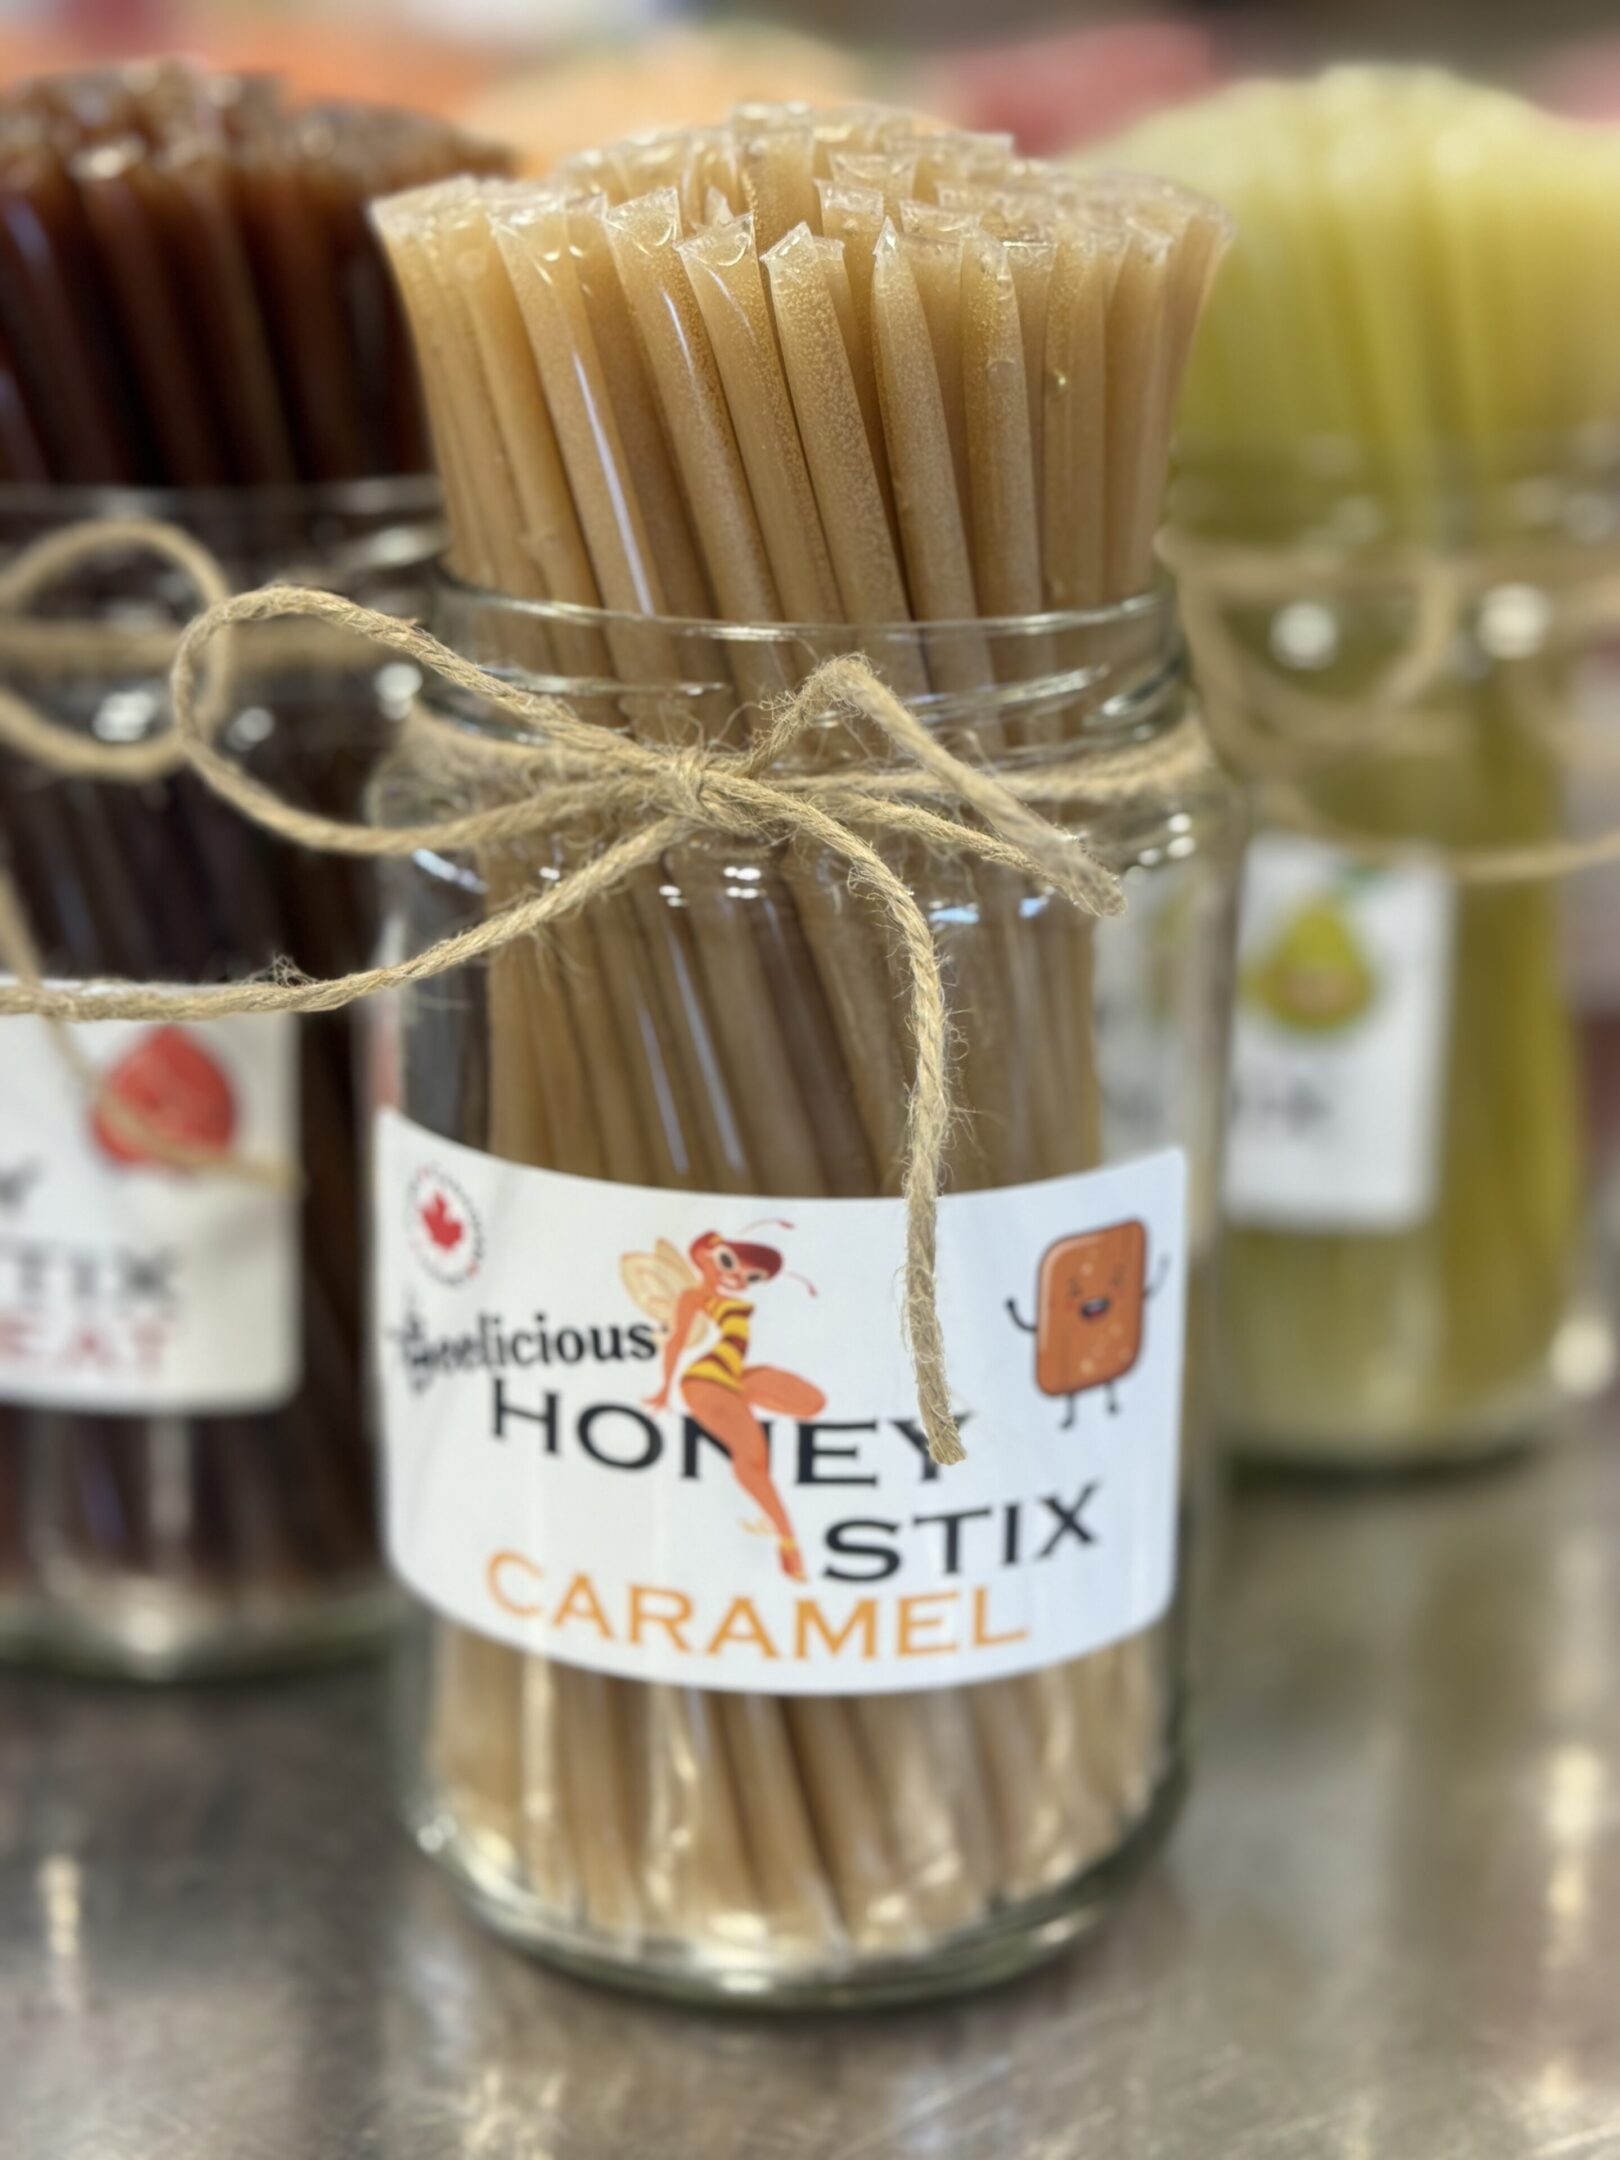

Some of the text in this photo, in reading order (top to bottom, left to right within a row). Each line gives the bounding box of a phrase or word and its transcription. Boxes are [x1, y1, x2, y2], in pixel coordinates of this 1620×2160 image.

[491, 1377, 975, 1488] HONEY
[821, 1482, 1103, 1583] STIX
[485, 1549, 1030, 1662] CARAMEL
